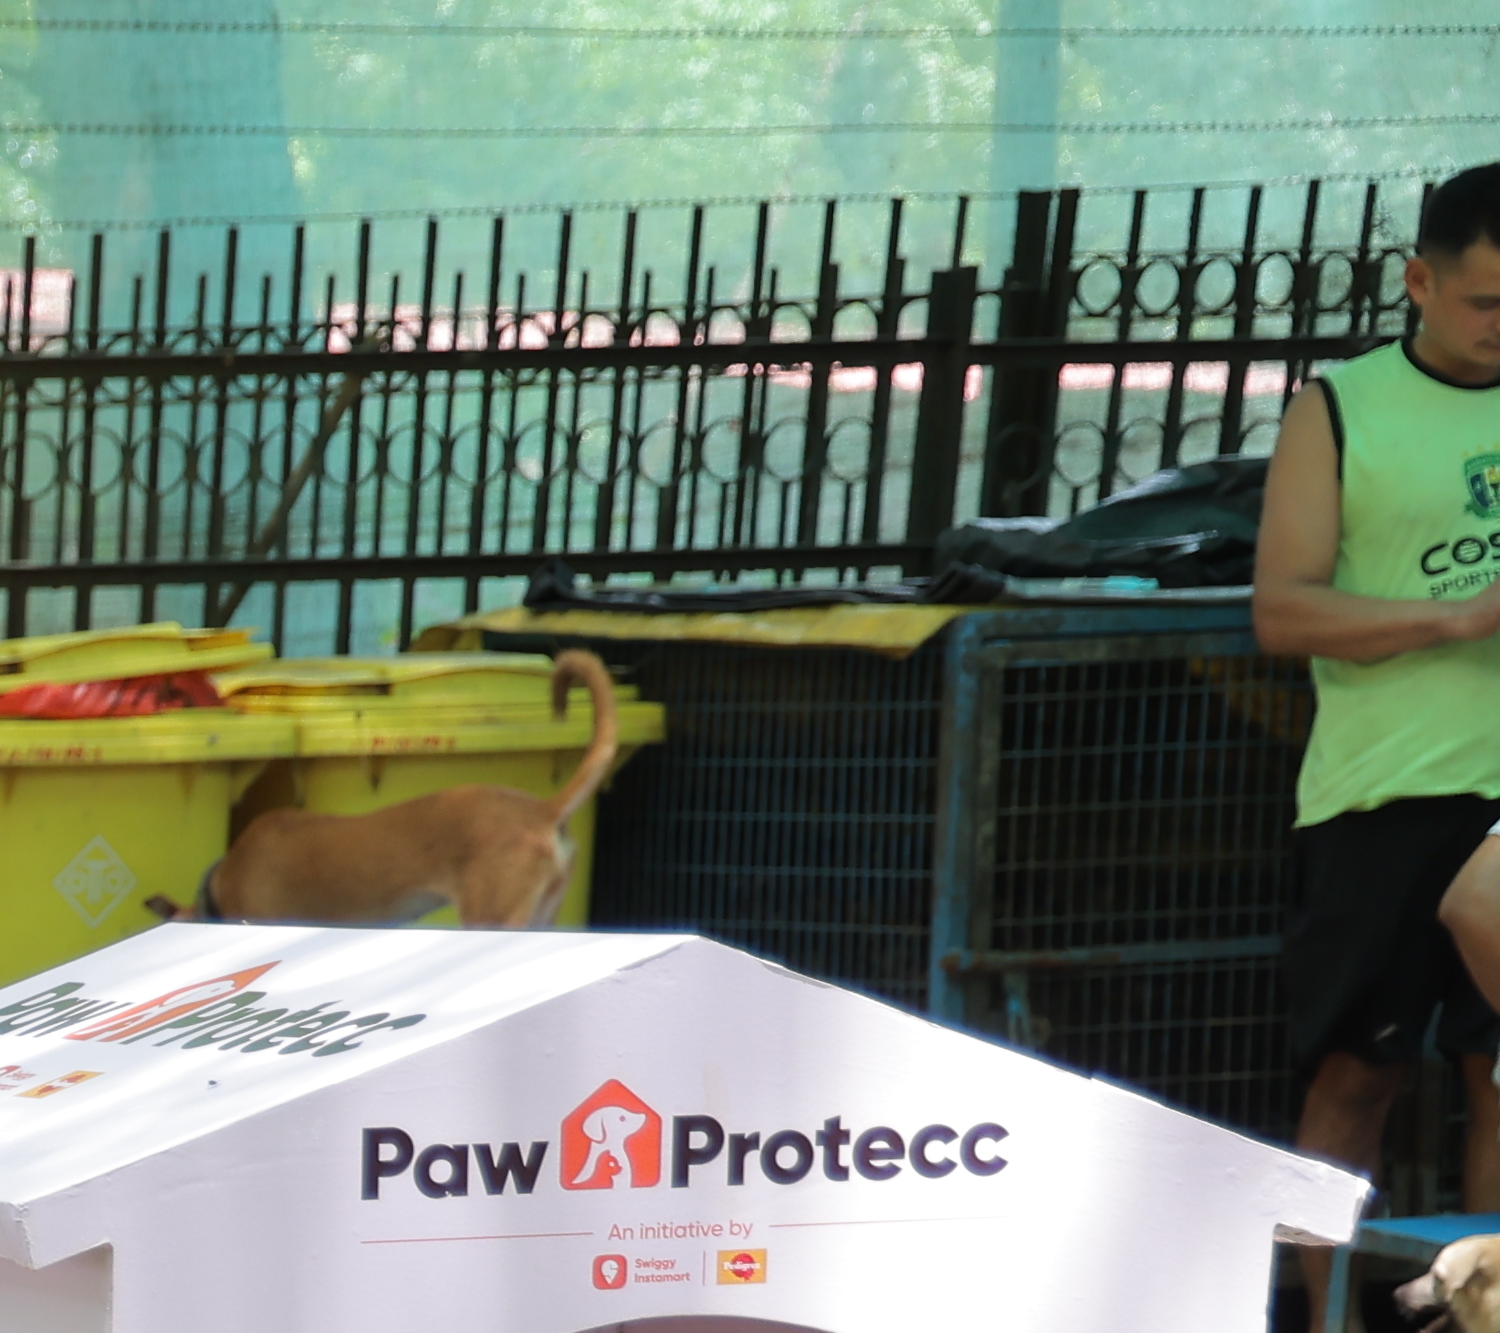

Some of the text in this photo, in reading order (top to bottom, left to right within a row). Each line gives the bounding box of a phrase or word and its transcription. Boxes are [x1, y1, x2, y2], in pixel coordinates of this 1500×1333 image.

[119, 990, 427, 1058] Protecc
[361, 1113, 1010, 1201] Paw Protecc
[608, 1219, 753, 1240] An initiative by
[634, 1258, 676, 1271] Swiggy
[634, 1272, 690, 1283] Instamart
